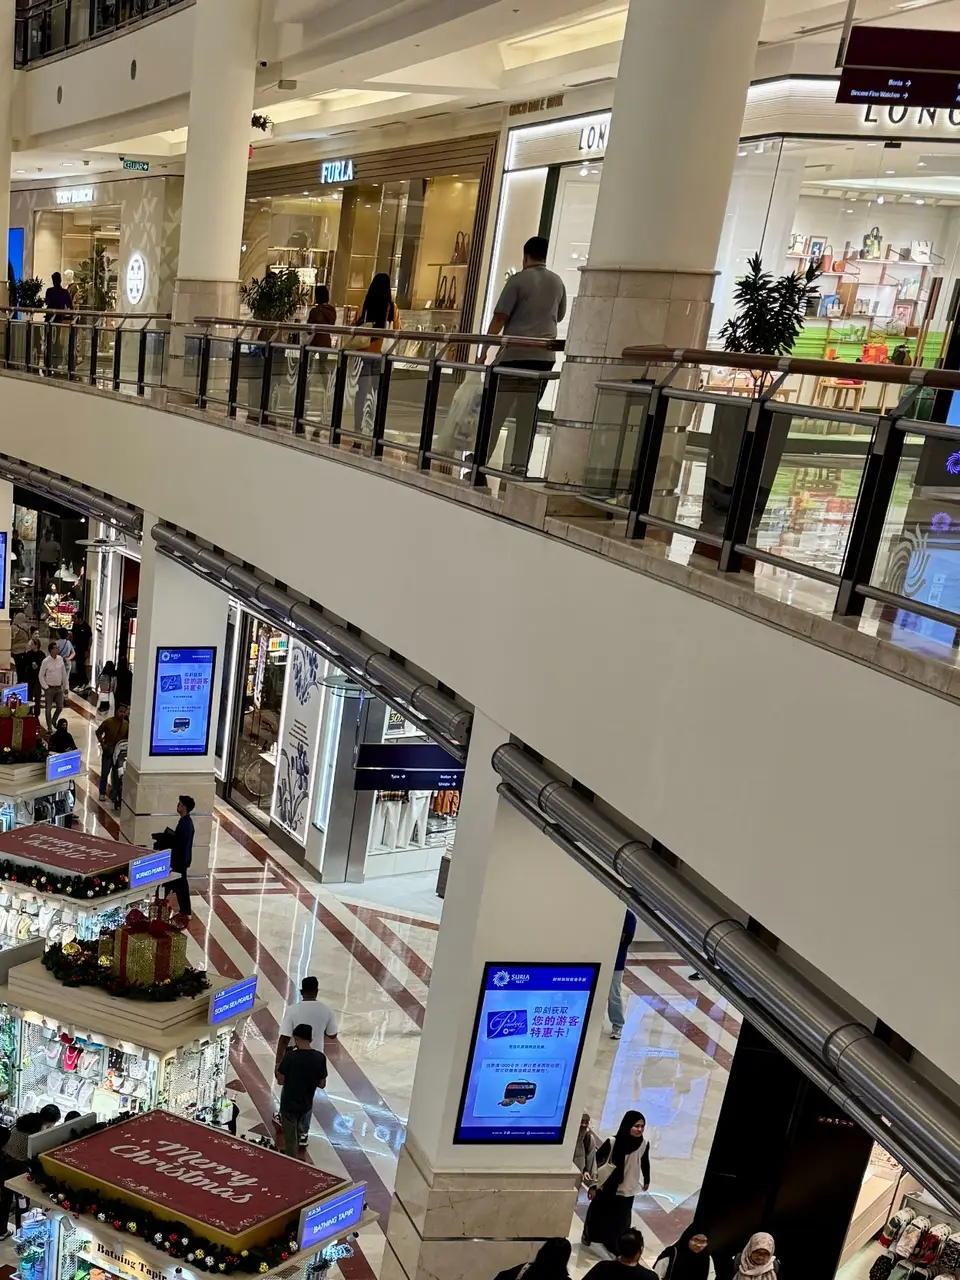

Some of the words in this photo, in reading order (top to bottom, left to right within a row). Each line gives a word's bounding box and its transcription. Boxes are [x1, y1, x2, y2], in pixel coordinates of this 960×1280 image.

[320, 159, 354, 184] FURLA
[511, 973, 530, 981] SURIA
[531, 1015, 579, 1027] 您的游客
[109, 1144, 254, 1204] Christmas
[157, 1139, 260, 1188] Merry
[313, 1216, 338, 1234] BATHING
[338, 1207, 354, 1221] TAPIR
